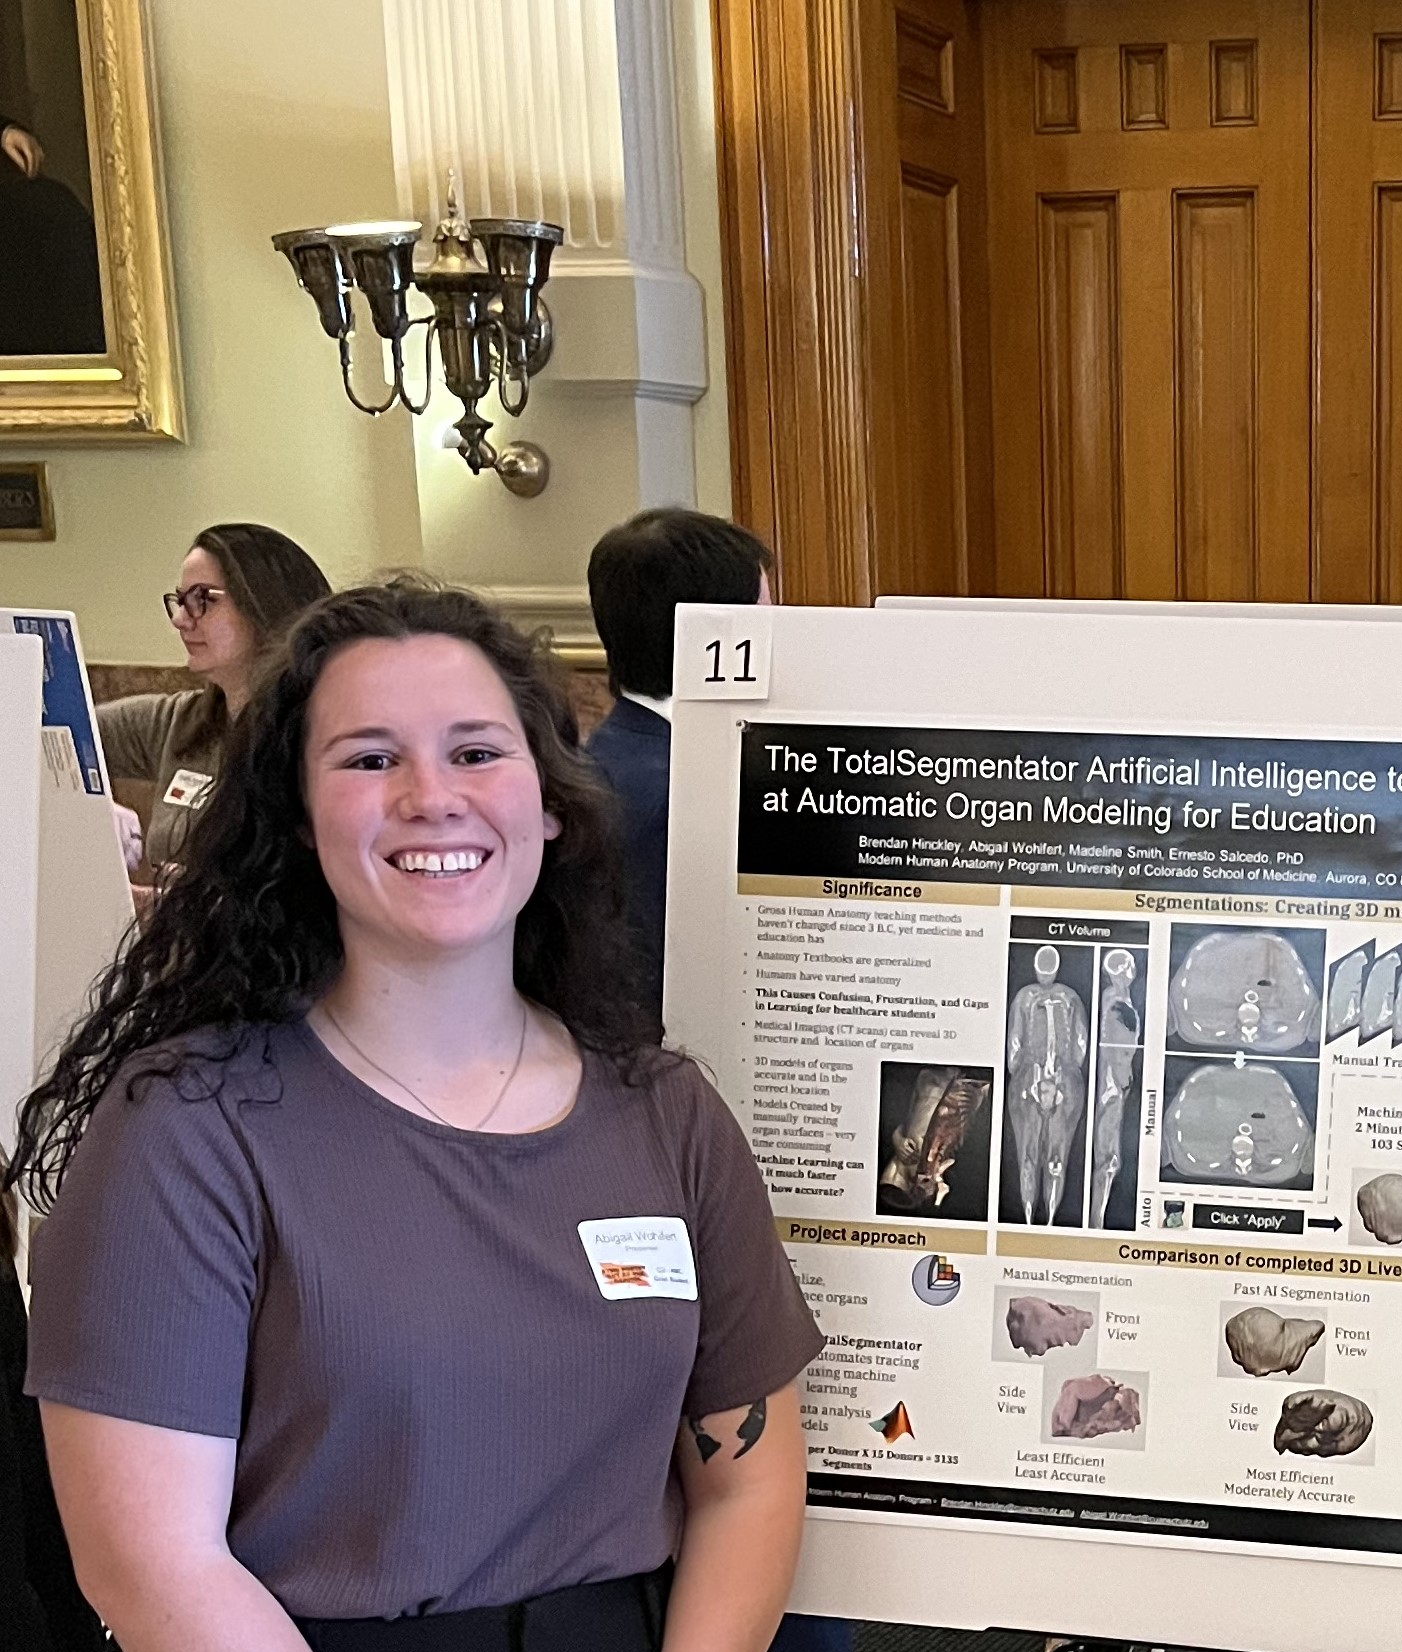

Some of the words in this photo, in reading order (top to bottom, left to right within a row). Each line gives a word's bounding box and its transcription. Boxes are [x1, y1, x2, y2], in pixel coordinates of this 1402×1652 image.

[703, 638, 759, 683] 11
[763, 745, 817, 773] The
[825, 746, 1079, 785] TotalSegmentator
[1085, 756, 1199, 786] Artificial
[1211, 760, 1376, 797] Intelligence
[762, 788, 789, 812] at
[795, 788, 937, 818] Automatic
[945, 793, 1032, 828] Organ
[1043, 796, 1171, 834] Modeling
[1181, 800, 1222, 829] for
[1230, 802, 1378, 834] Education
[858, 836, 909, 849] Brendan
[967, 840, 1008, 856] Abigail
[1068, 844, 1122, 858] Madeline
[1126, 846, 1164, 861] Smith,
[1168, 847, 1215, 861] Ernesto
[1276, 852, 1304, 865] PhD
[857, 853, 903, 866] Modern
[905, 855, 949, 867] Human
[950, 857, 1004, 873] Anatomy
[1065, 861, 1125, 878] University
[1127, 863, 1141, 876] of
[1143, 864, 1199, 878] Colorado
[1201, 866, 1244, 880] School
[1246, 868, 1261, 880] of
[1325, 871, 1370, 886] Aurora,
[1375, 873, 1397, 886] CO
[822, 880, 923, 899] Significance
[1133, 893, 1268, 913] Segmentations:
[1274, 899, 1351, 921] Creating
[1354, 902, 1379, 917] 3D
[1047, 923, 1066, 935] CT
[1067, 924, 1111, 937] Volume
[755, 968, 797, 980] Humans
[798, 970, 823, 982] have
[824, 973, 856, 983] varied
[857, 976, 901, 987] anatomy
[1331, 1054, 1379, 1067] Manual
[1145, 1089, 1157, 1137] Manual
[1354, 1122, 1363, 1133] 2
[1370, 1139, 1393, 1150] 103
[1141, 1197, 1152, 1228] Auto
[1209, 1211, 1240, 1225] Click
[789, 1223, 847, 1244] Project
[849, 1230, 926, 1247] approach
[1117, 1244, 1219, 1265] Comparison
[1223, 1252, 1241, 1266] of
[1245, 1256, 1333, 1273] completed
[1338, 1259, 1361, 1274] 3D
[1001, 1267, 1049, 1281] Manual
[1050, 1271, 1133, 1287] Segmentation
[1263, 1285, 1277, 1297] AI
[1279, 1286, 1370, 1303] Segmentation
[1105, 1311, 1141, 1326] Front
[825, 1334, 923, 1351] talSegmentator
[1107, 1328, 1138, 1341] View
[1334, 1327, 1371, 1342] Front
[1335, 1344, 1368, 1358] View
[805, 1366, 841, 1382] using
[842, 1369, 896, 1383] machine
[806, 1381, 858, 1398] learning
[999, 1385, 1026, 1399] Side
[997, 1402, 1027, 1415] View
[1230, 1403, 1259, 1416] Side
[1228, 1419, 1259, 1432] View
[1016, 1450, 1049, 1463] Least
[1052, 1452, 1105, 1467] Efficient
[1014, 1465, 1047, 1479] Least
[1049, 1469, 1106, 1484] Accurate
[1245, 1468, 1276, 1481] Most
[1279, 1470, 1333, 1485] Efficient
[1223, 1483, 1295, 1502] Moderately
[1296, 1488, 1355, 1504] Accurate
